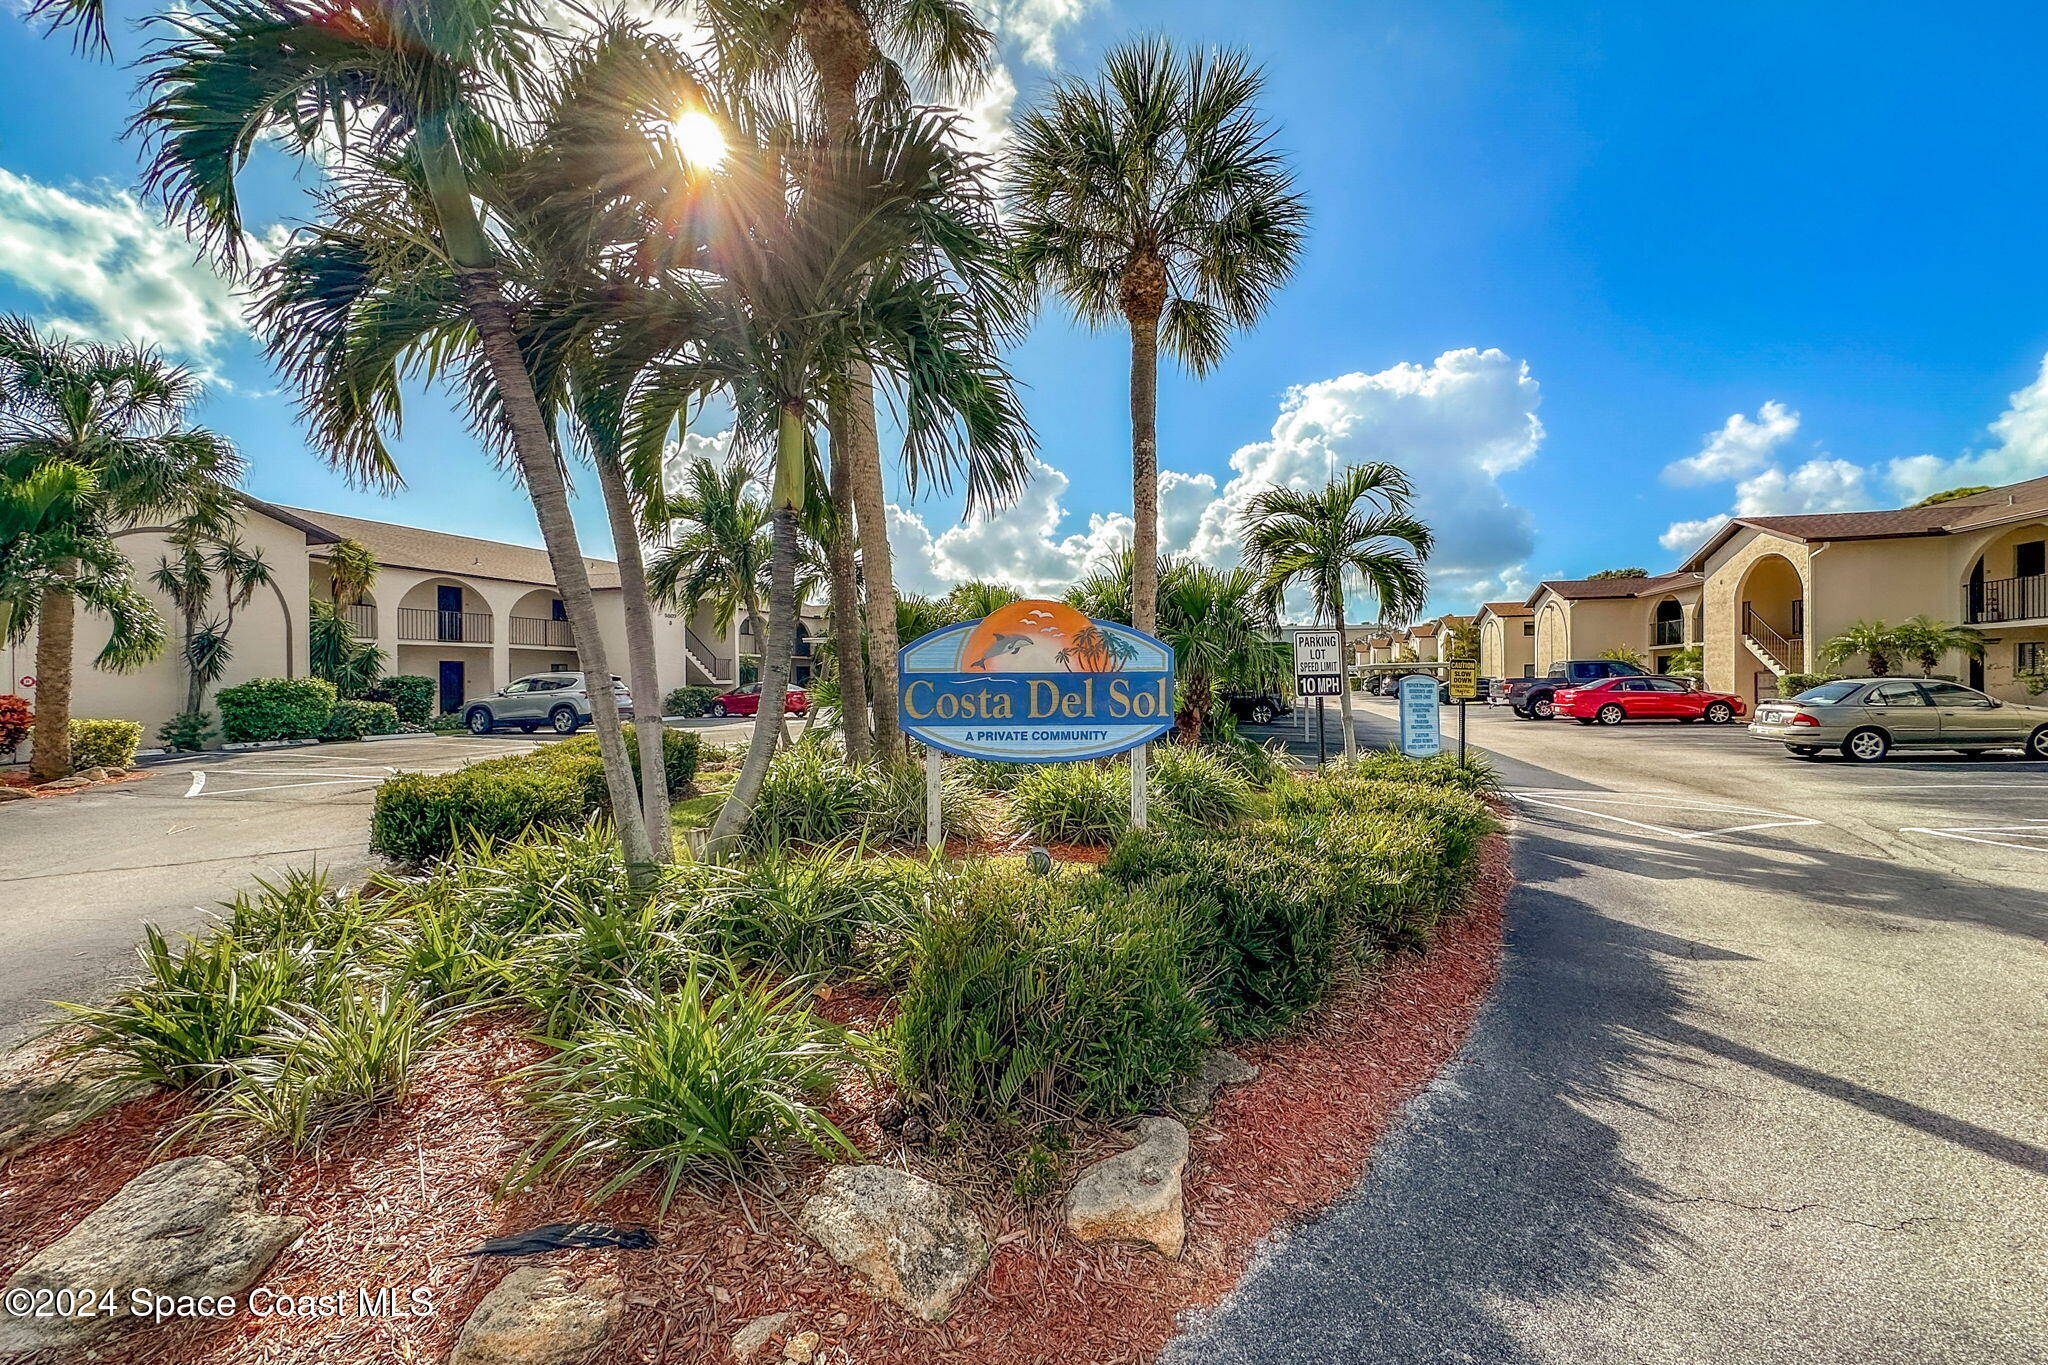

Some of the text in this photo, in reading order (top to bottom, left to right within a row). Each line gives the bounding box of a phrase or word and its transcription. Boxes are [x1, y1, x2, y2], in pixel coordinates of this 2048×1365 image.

[1298, 636, 1336, 647] PARKING
[1310, 649, 1326, 660] LOT
[1300, 661, 1337, 672] SPEED LIMIT
[1300, 677, 1340, 693] 10 MPH
[904, 677, 1170, 720] Costa Del Sol
[965, 730, 1108, 741] A PRIVATE COMMUNITY
